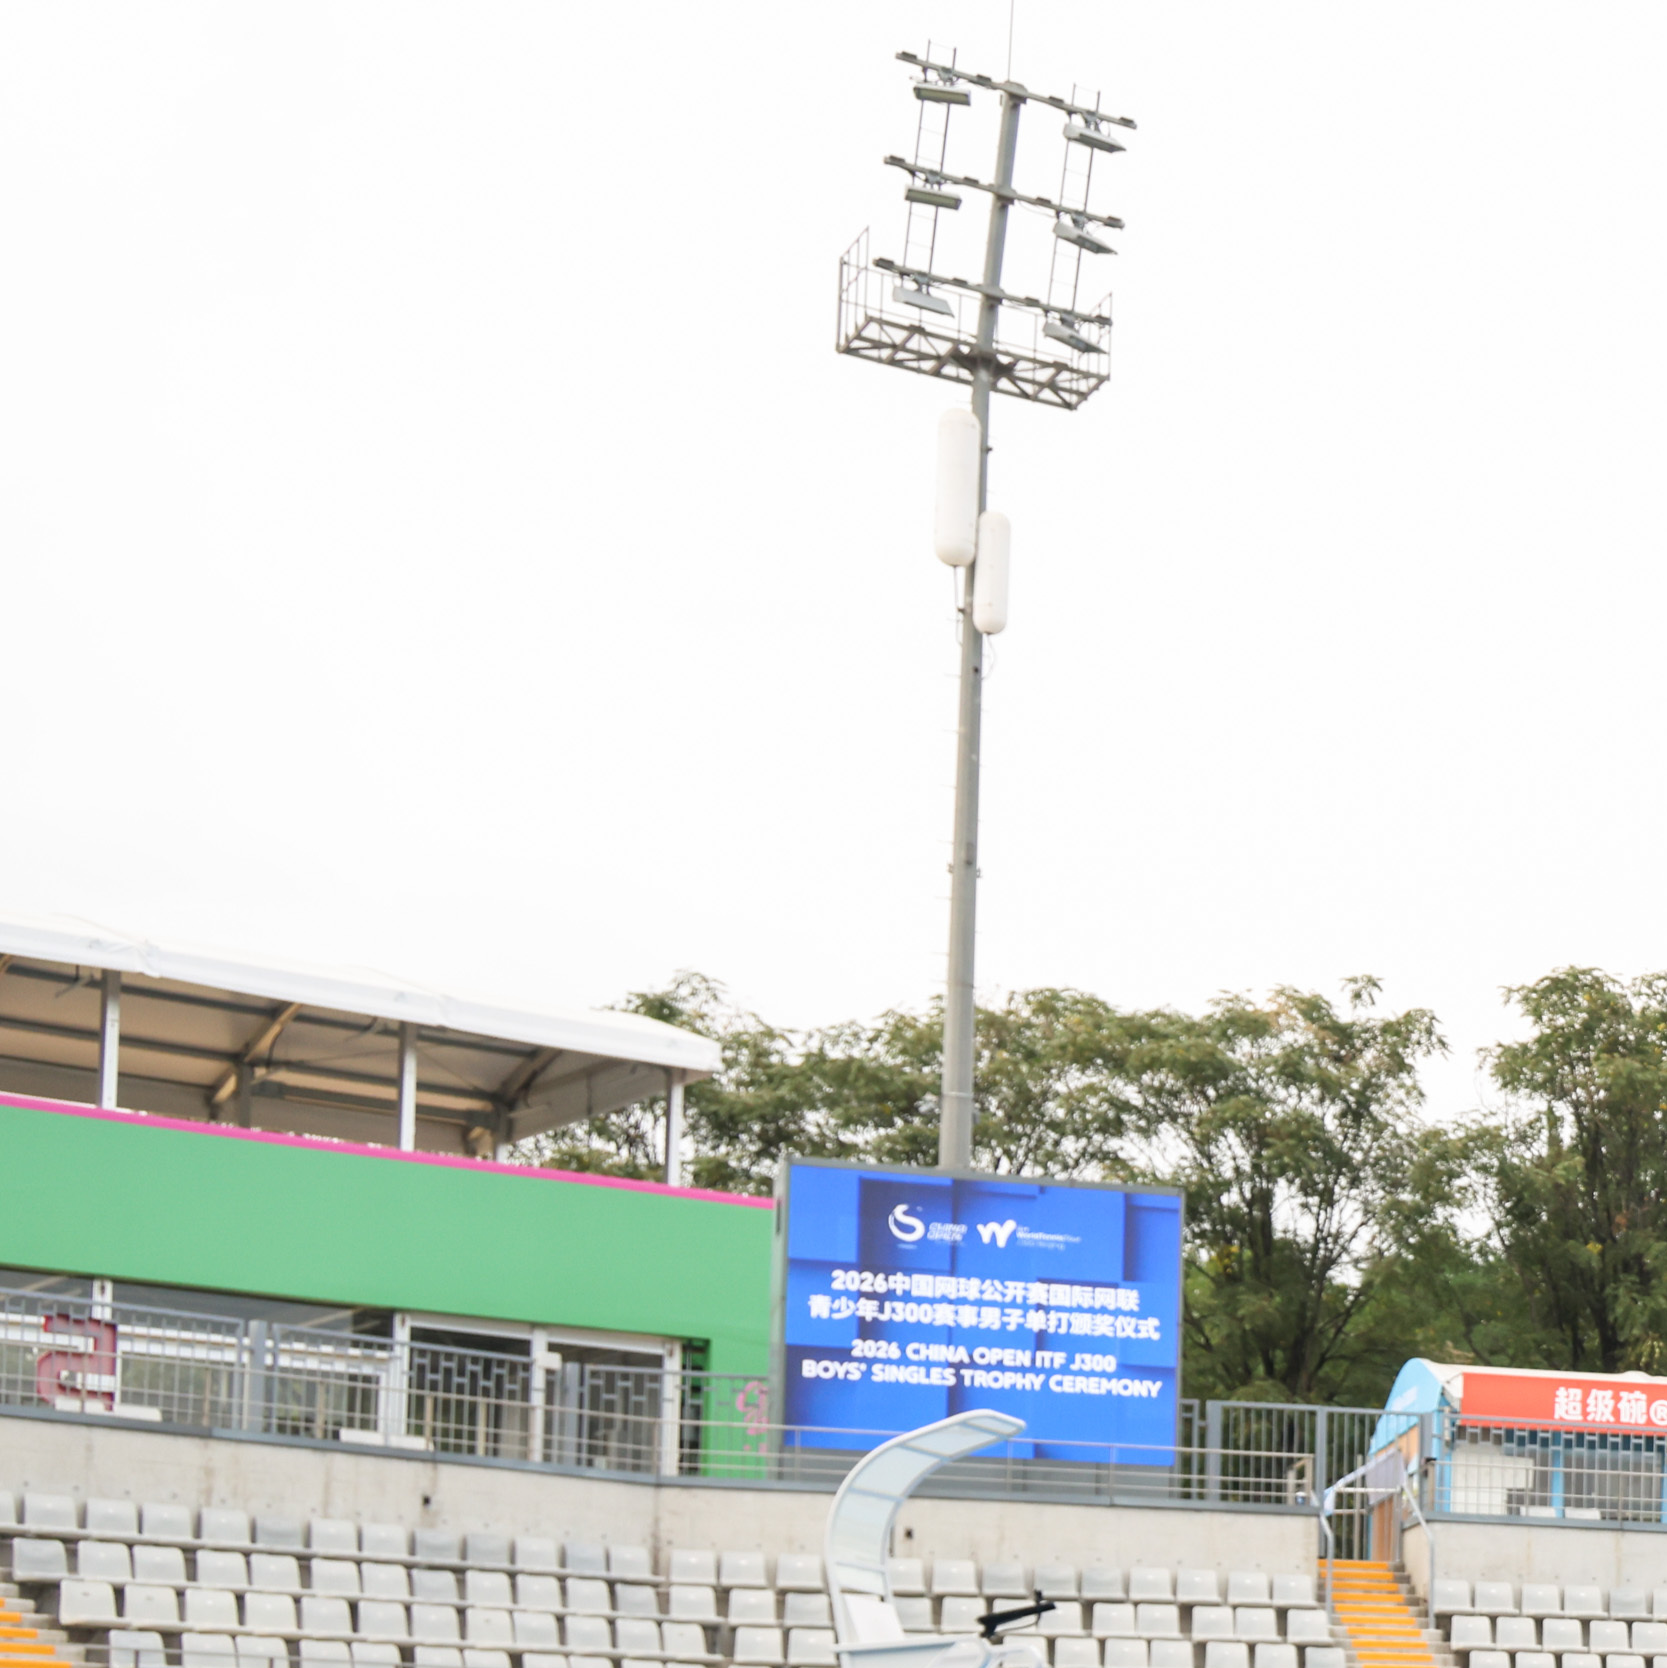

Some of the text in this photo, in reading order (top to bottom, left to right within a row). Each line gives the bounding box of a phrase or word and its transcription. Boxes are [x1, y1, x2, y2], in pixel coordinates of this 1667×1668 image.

[851, 1339, 1117, 1373] 2026 CHINA OPEN ITF J300
[801, 1359, 1163, 1398] BOYS' SINGLES TROPHY CEREMONY
